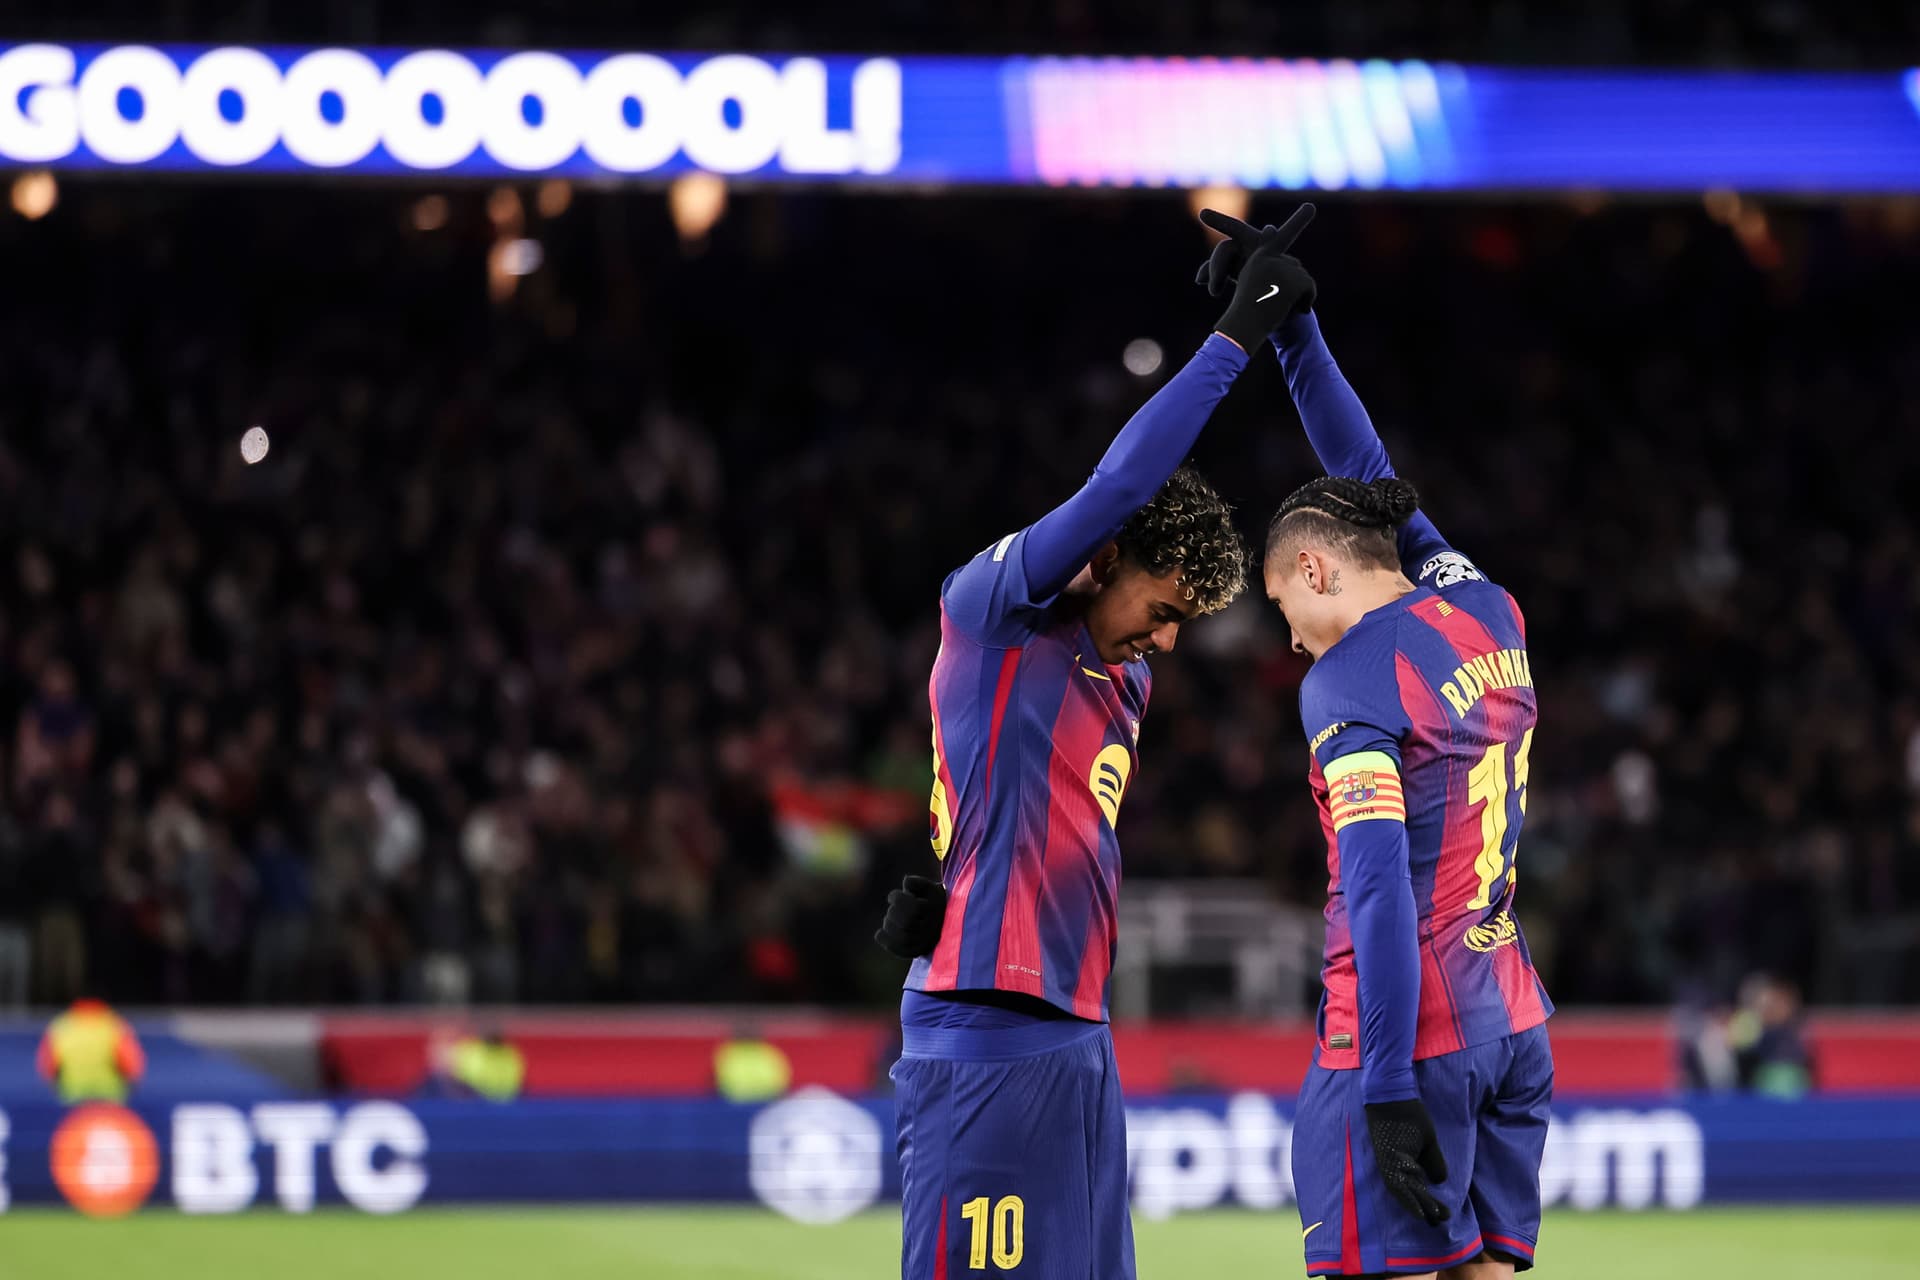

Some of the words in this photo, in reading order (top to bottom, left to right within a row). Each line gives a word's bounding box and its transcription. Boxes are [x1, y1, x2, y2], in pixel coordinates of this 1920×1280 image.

[0, 44, 903, 175] GOOOOOOOL!
[1310, 722, 1339, 755] LIGHT
[171, 1102, 430, 1214] BTC
[961, 1194, 1025, 1270] 10
